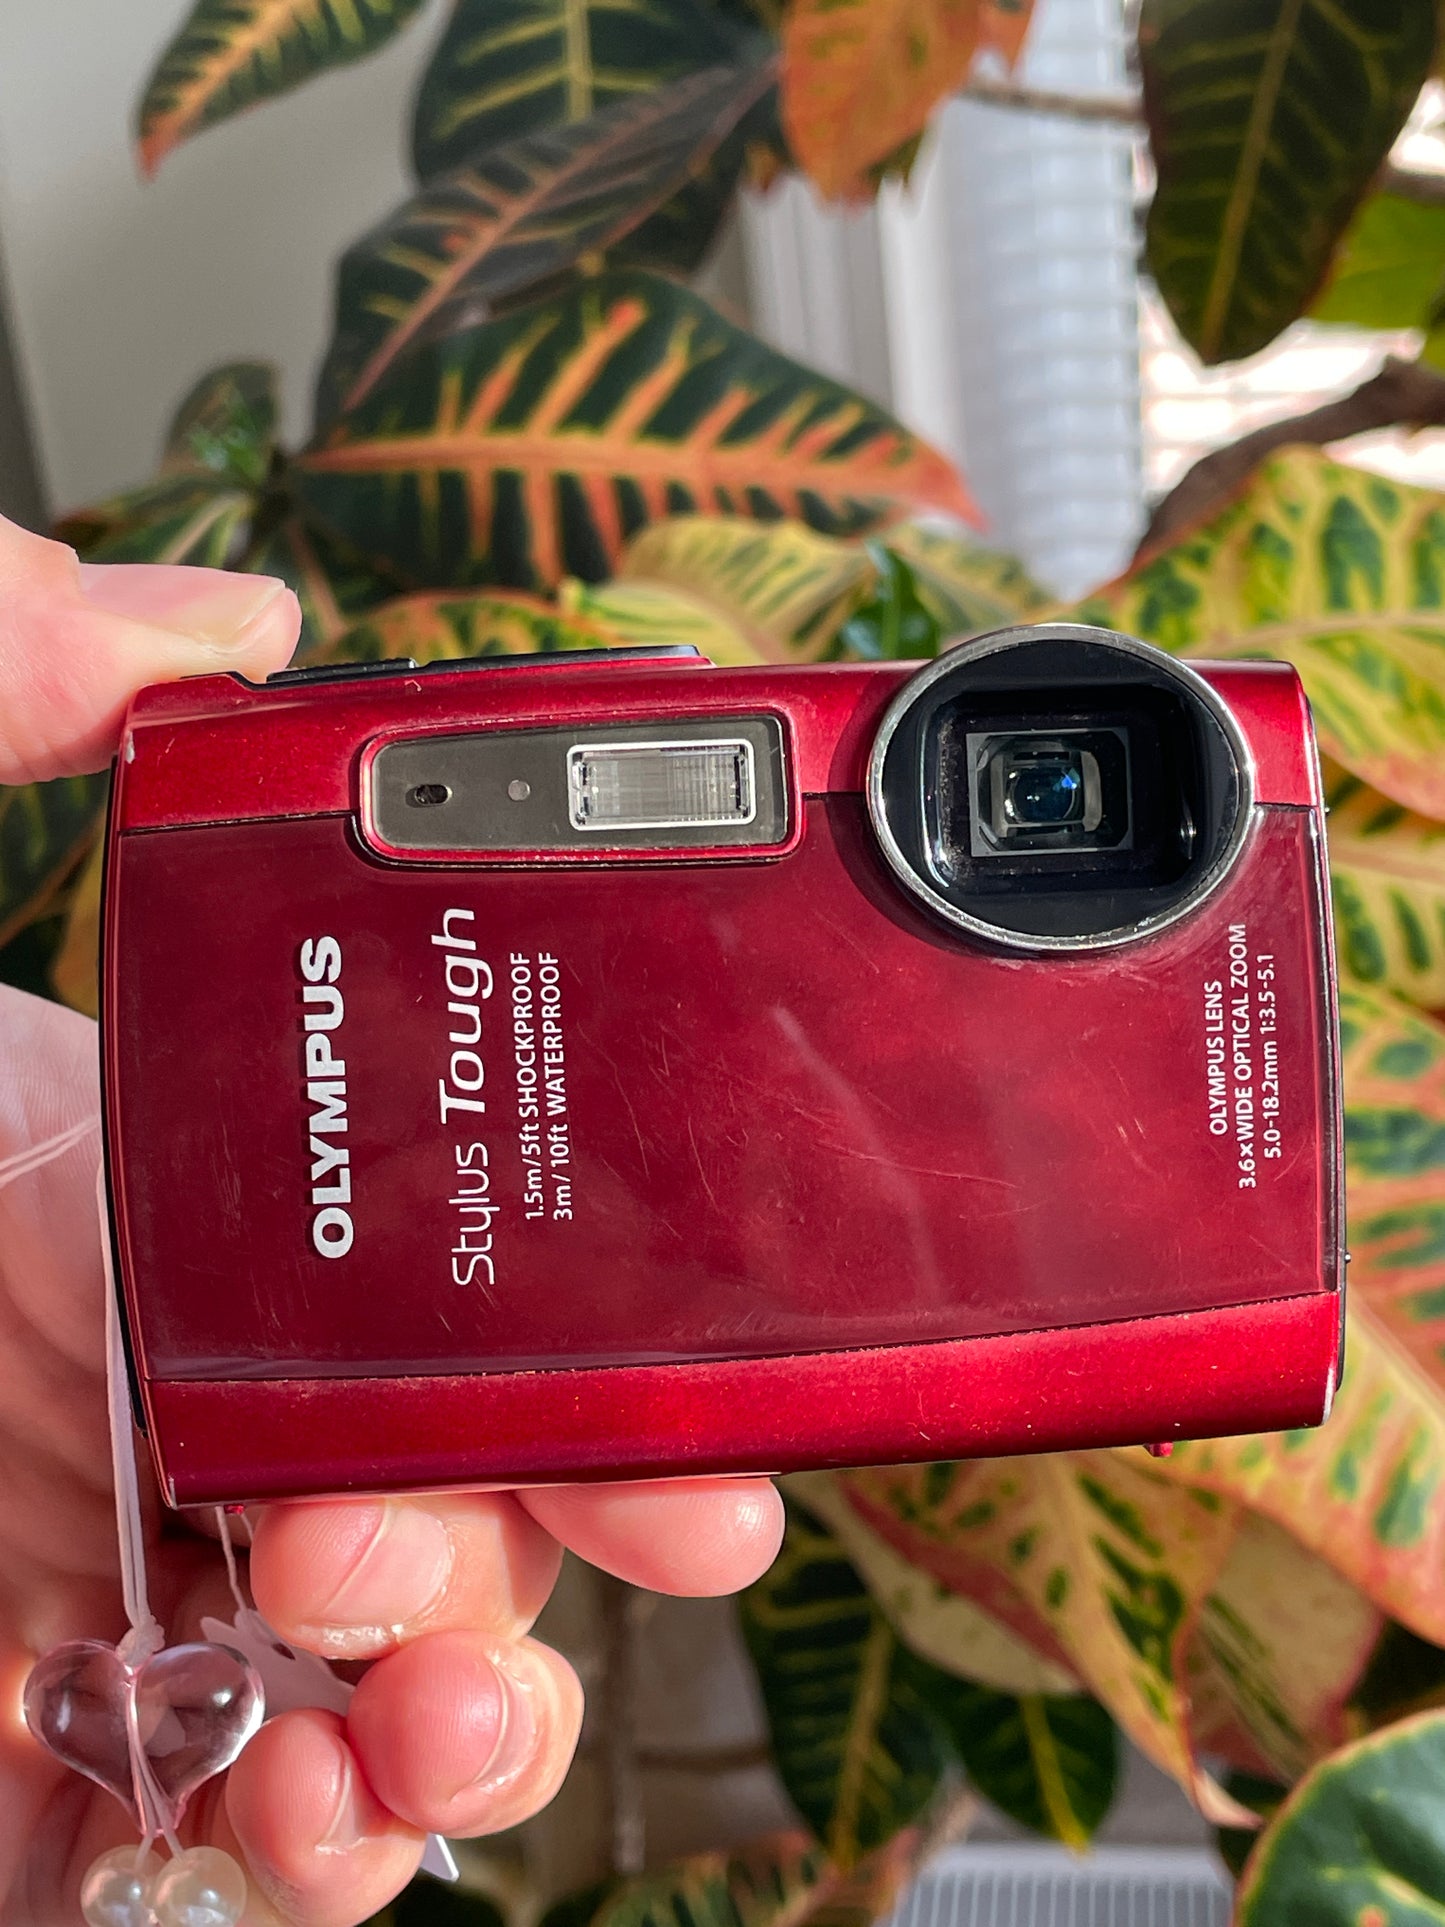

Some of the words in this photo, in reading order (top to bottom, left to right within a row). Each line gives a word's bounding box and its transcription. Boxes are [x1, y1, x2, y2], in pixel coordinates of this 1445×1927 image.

[1204, 979, 1224, 1032] LENS
[1228, 923, 1248, 988] ZOOM
[1257, 954, 1277, 1035] 1:3.5-5.1
[431, 908, 494, 1124] Tough
[510, 952, 540, 1118] SHOCKPROOF
[538, 952, 567, 1117] WATERPROOF
[1231, 992, 1252, 1081] OPTICAL
[300, 935, 354, 1259] OLYMPUS
[1206, 1036, 1228, 1135] OLYMPUS
[1262, 1040, 1282, 1158] 5.0-18.2mm
[448, 1142, 501, 1286] Stylus
[519, 1122, 544, 1220] 1.5m/5ft
